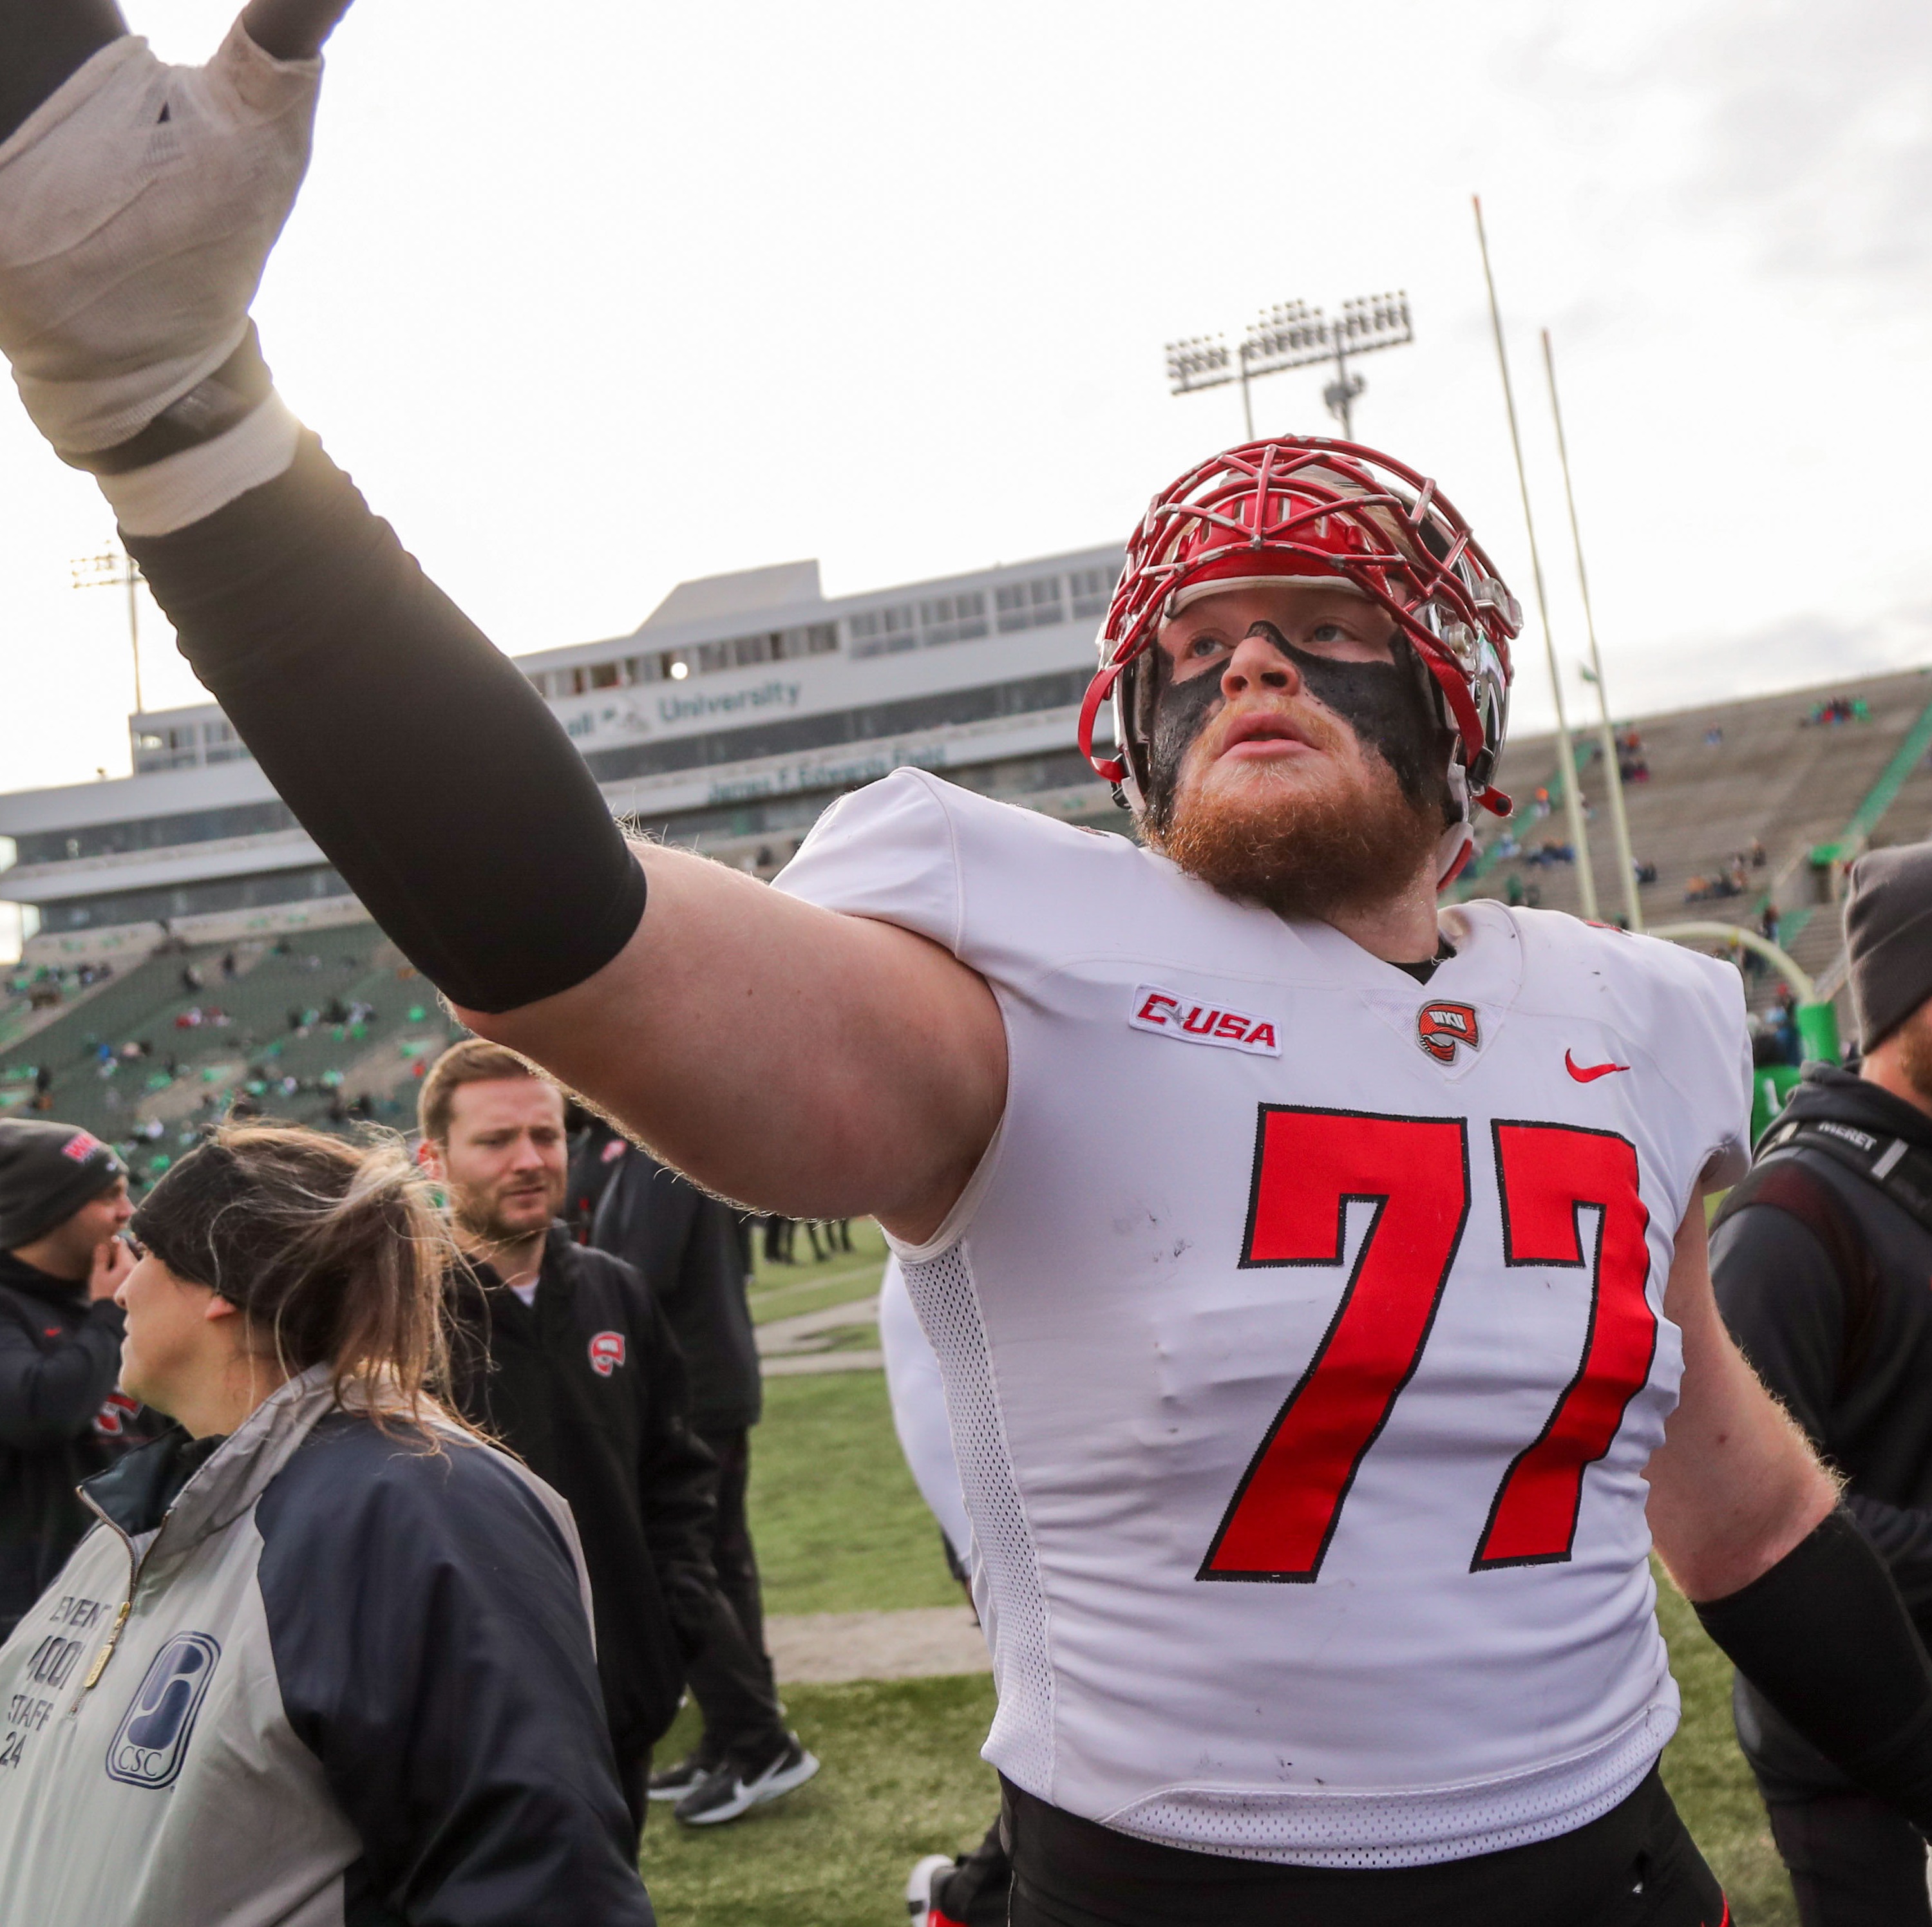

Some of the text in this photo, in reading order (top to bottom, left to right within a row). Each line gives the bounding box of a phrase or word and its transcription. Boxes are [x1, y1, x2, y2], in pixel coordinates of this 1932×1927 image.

[658, 680, 800, 722] University
[1428, 1010, 1467, 1031] WKU
[1195, 1102, 1658, 1583] 77
[118, 1745, 163, 1777] CSC
